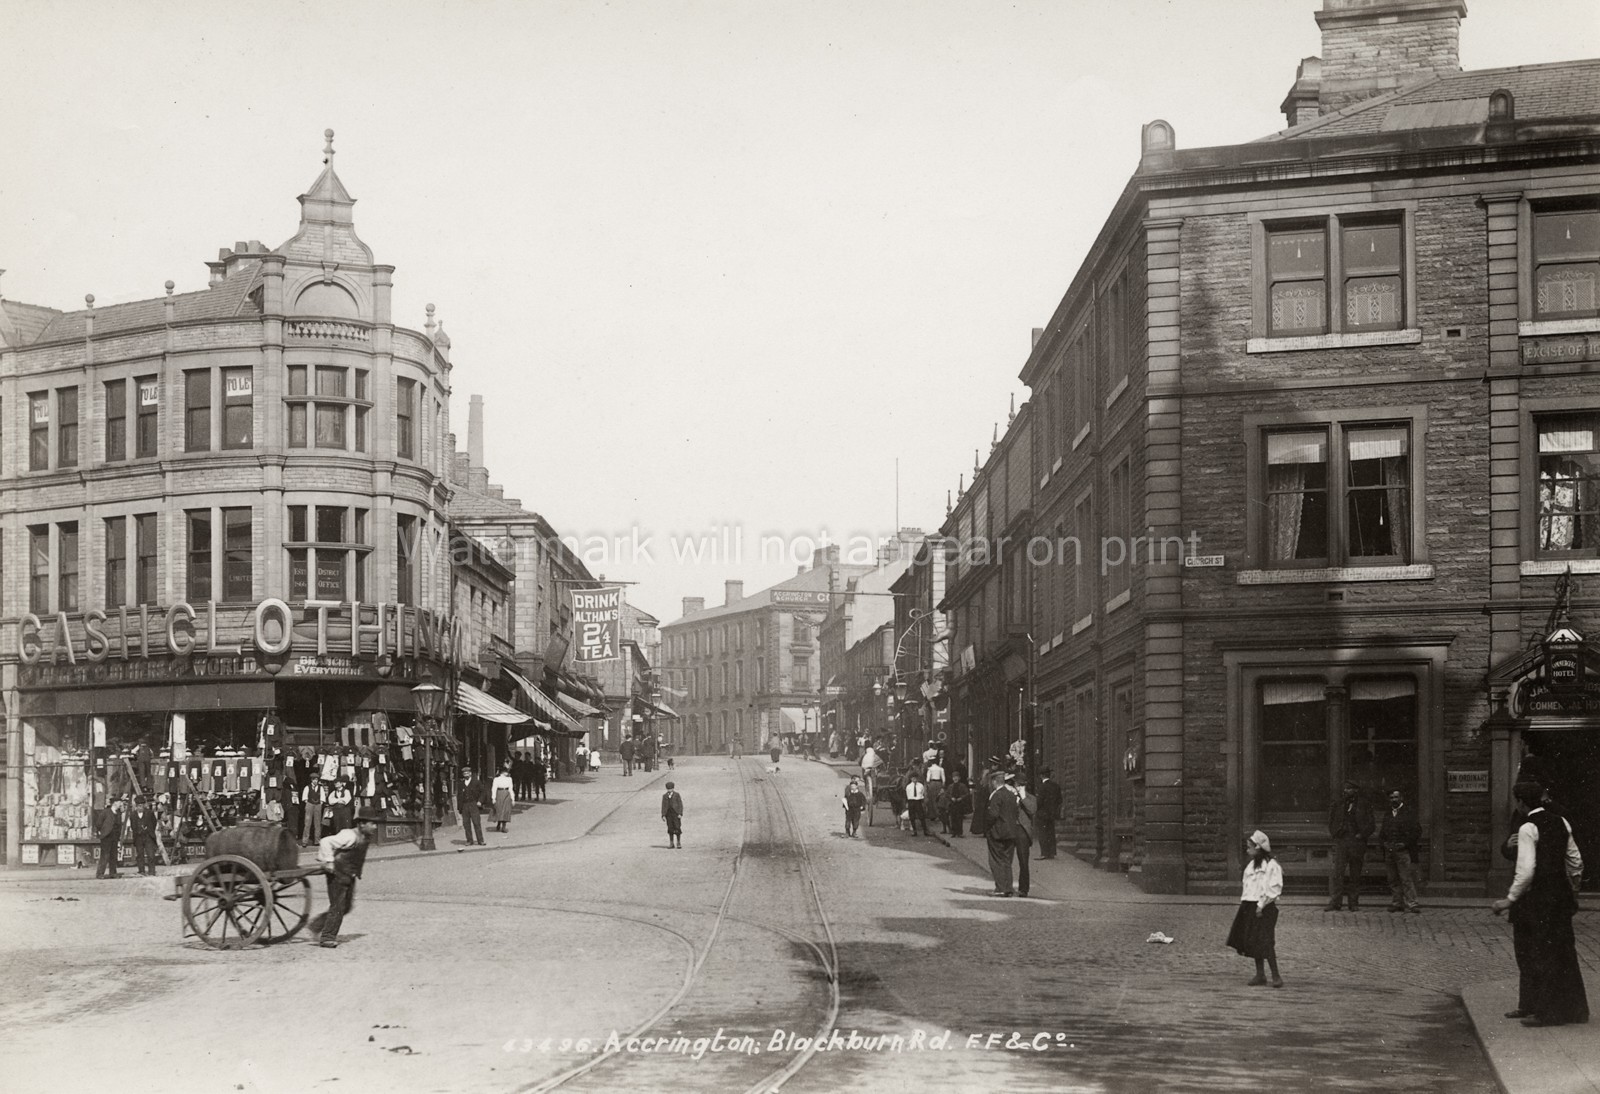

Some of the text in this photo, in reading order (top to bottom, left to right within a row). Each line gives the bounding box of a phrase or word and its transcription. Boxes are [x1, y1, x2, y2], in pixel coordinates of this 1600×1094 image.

[1526, 345, 1565, 358] EXCISE
[317, 580, 340, 588] OFFICE
[574, 592, 619, 609] DRINK
[18, 603, 149, 666] CASH
[580, 643, 614, 660] TEA
[1552, 669, 1577, 678] HOTEL
